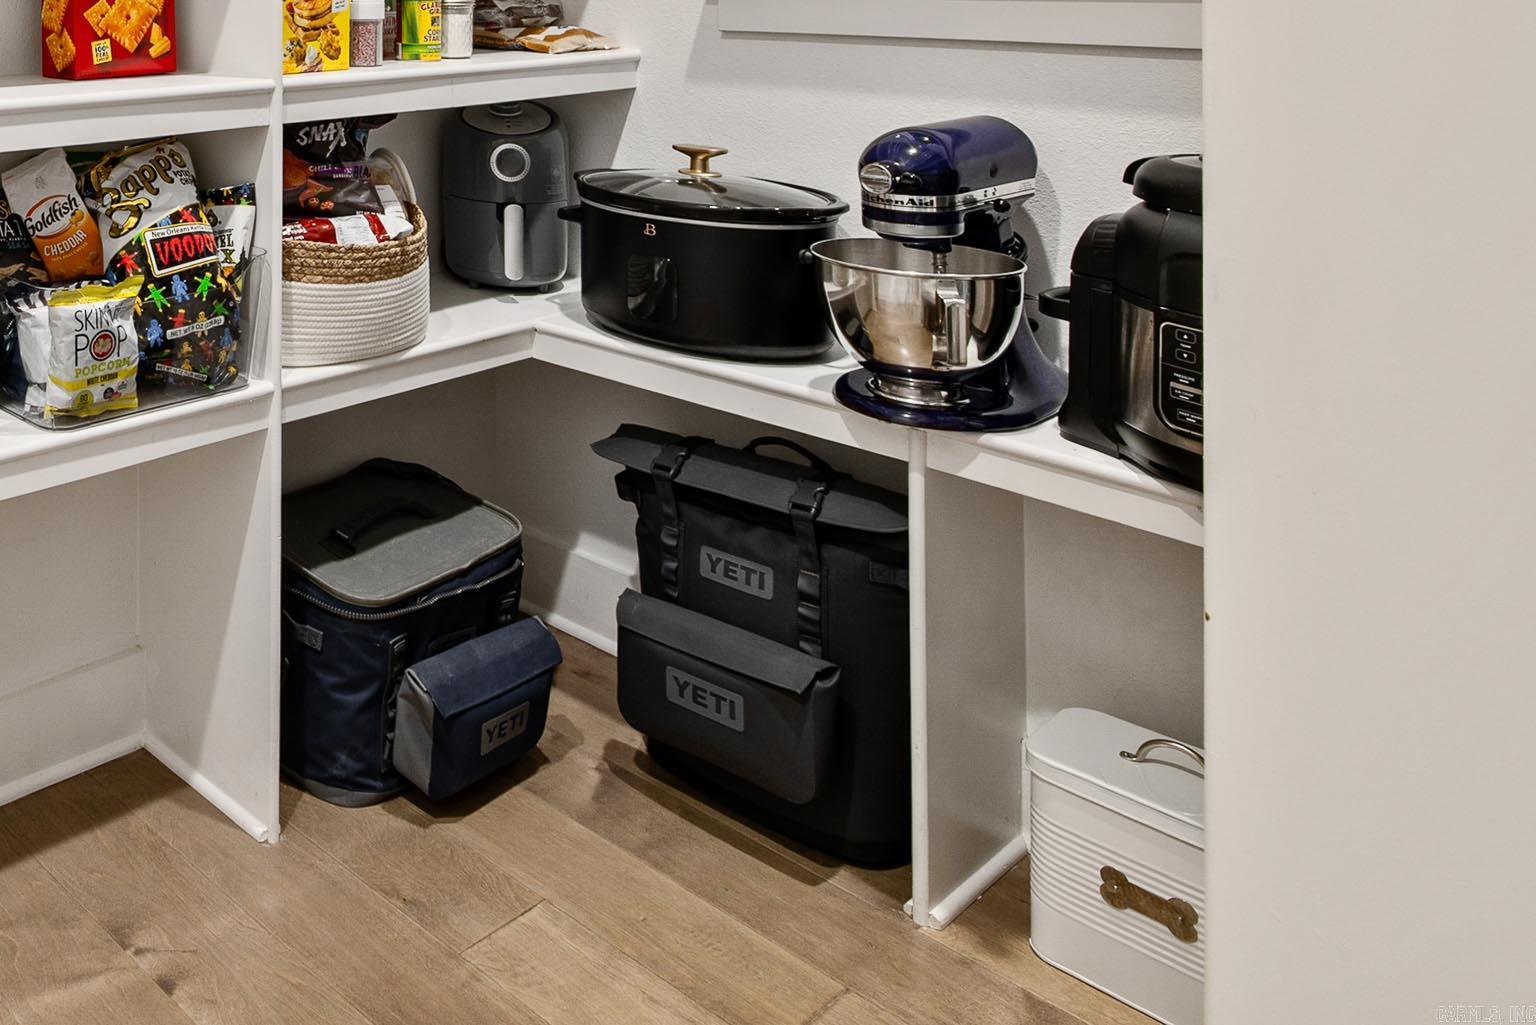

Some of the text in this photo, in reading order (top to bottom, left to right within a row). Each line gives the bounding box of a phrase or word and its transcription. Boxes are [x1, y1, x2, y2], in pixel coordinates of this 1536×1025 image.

[296, 122, 347, 157] SNAX
[24, 194, 79, 239] Goldfish
[44, 230, 88, 257] CHEDDAR
[74, 331, 127, 367] POP
[74, 356, 131, 378] POPCORN
[702, 552, 767, 591] YETI
[672, 676, 736, 721] YETI
[484, 710, 525, 747] YETI
